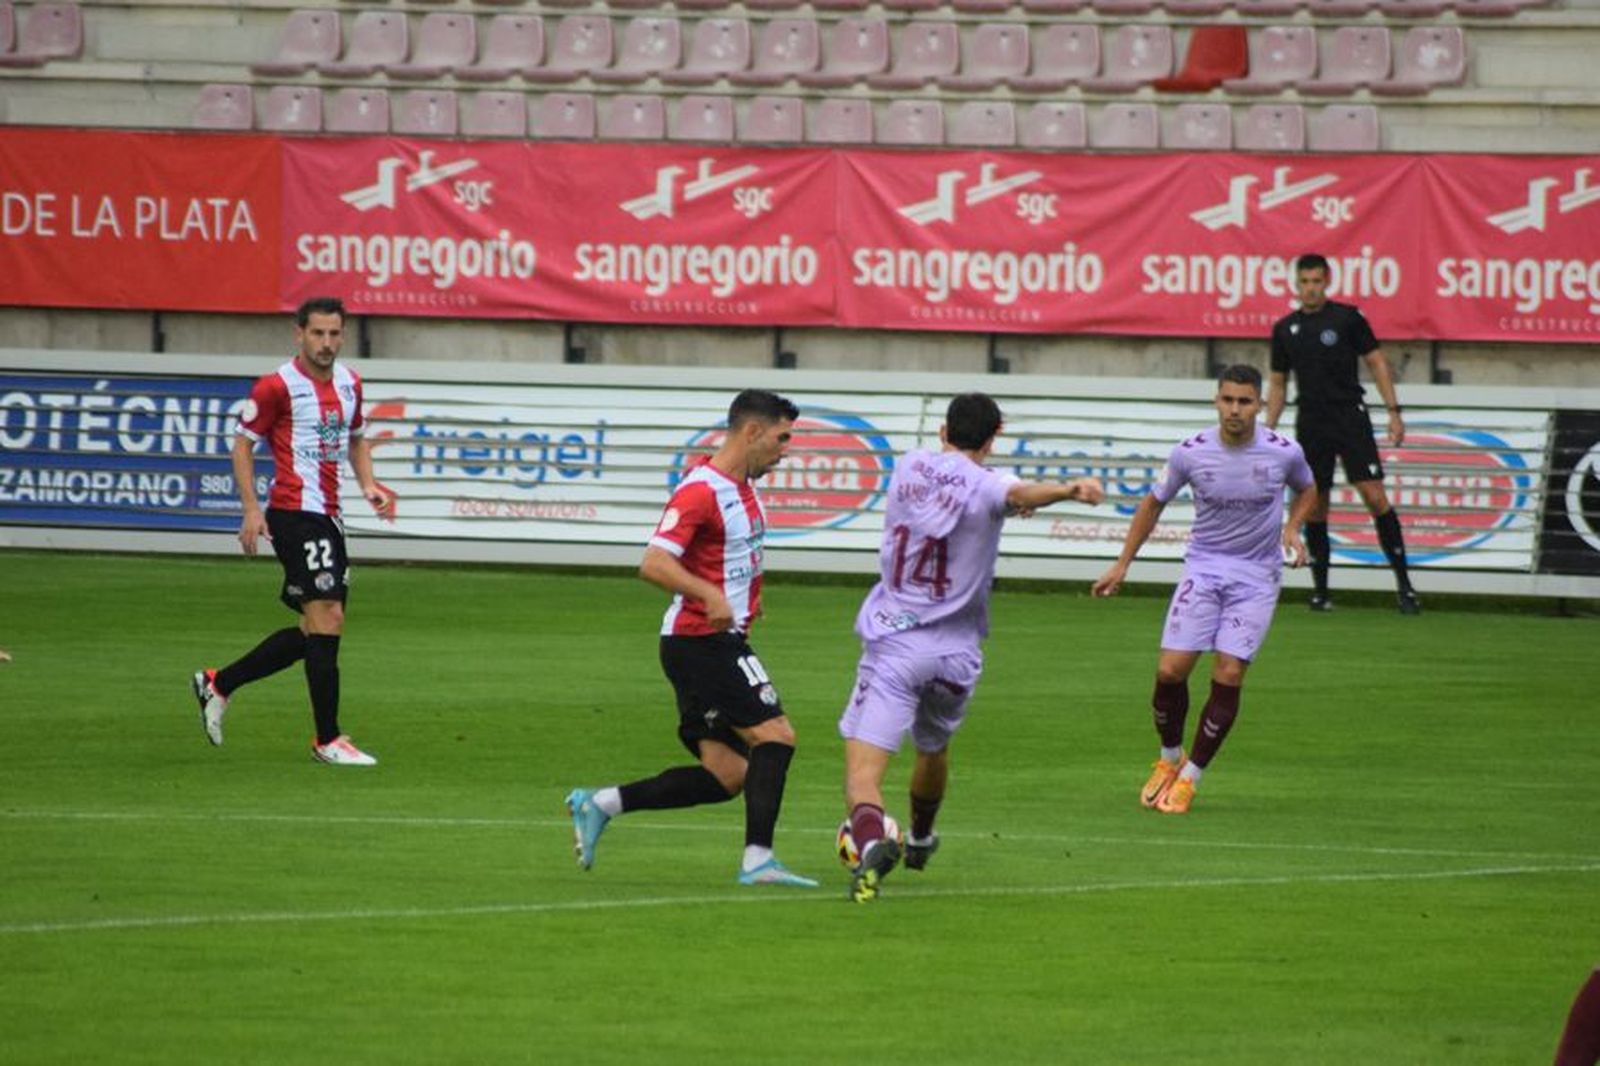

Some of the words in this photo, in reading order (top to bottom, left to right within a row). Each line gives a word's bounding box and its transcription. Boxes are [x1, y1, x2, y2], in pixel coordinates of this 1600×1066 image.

[453, 178, 493, 212] sgc
[732, 186, 774, 219] sgc
[1016, 192, 1058, 225] sgc
[1311, 193, 1356, 229] sgc
[2, 192, 56, 236] DE
[72, 194, 121, 238] LA
[135, 196, 257, 241] PLATA
[296, 229, 537, 289] sangregorio
[573, 234, 818, 298] sangregorio
[852, 242, 1103, 305] sangregorio
[413, 419, 607, 489] freigel
[0, 469, 187, 506] ZAMORANO
[201, 475, 233, 495] 980
[303, 539, 335, 571] 22
[892, 523, 953, 602] 14
[1178, 578, 1195, 604] 2
